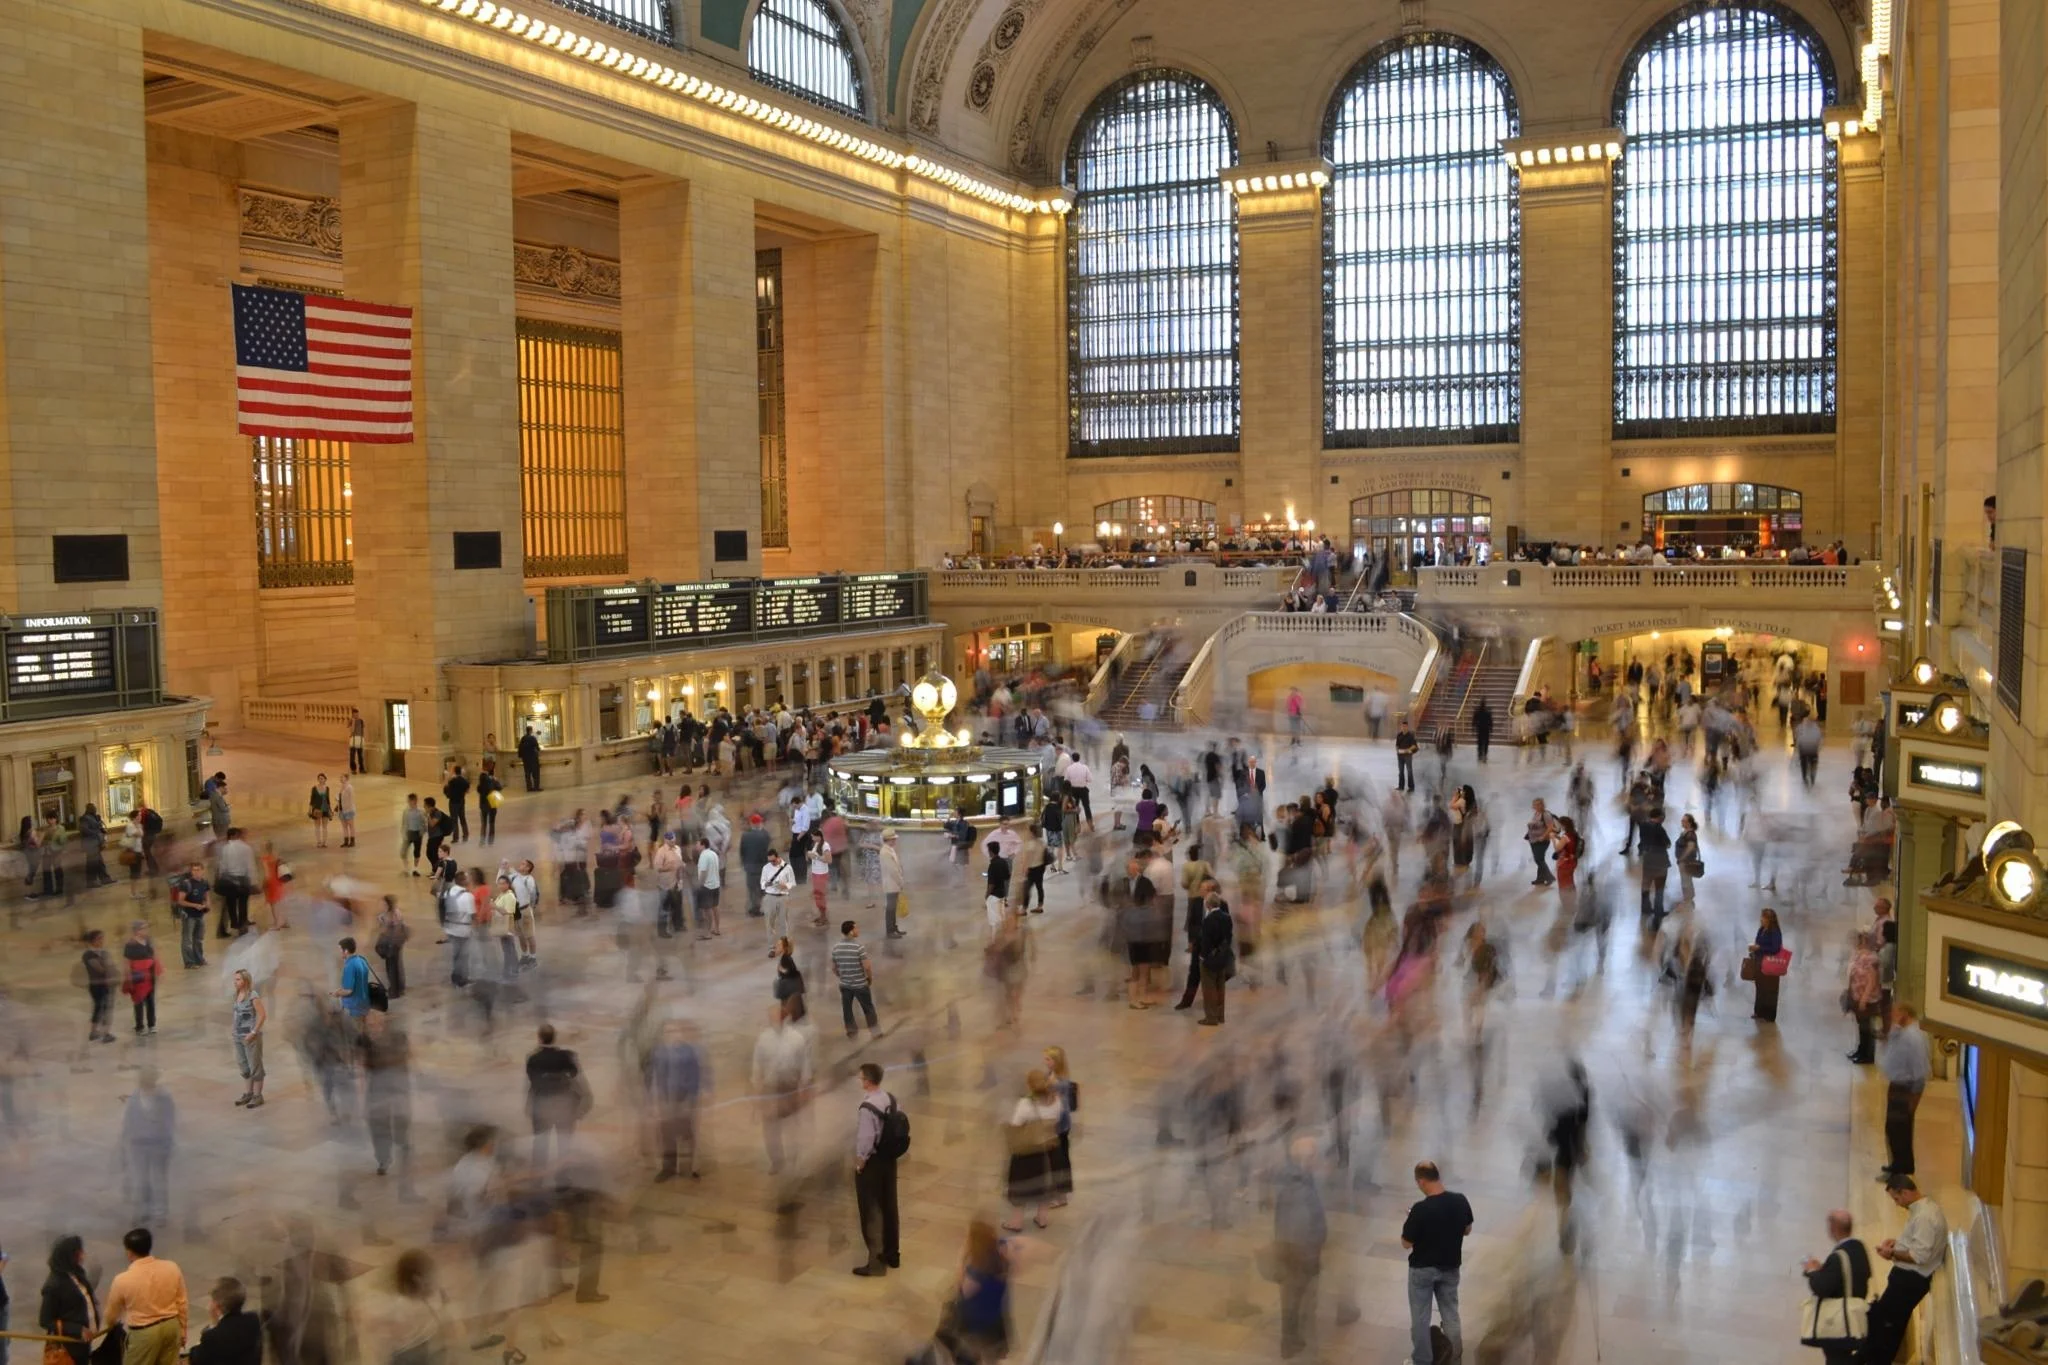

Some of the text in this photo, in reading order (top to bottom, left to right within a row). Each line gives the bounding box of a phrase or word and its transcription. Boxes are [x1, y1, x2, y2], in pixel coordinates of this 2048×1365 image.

[603, 587, 637, 595] INFORMATION
[25, 616, 91, 627] INFORMATION
[1592, 617, 1678, 633] TICKET MACHINES
[1711, 617, 1751, 628] TRACKS
[1920, 766, 1961, 784] TRACK
[1966, 964, 2044, 1005] TRACK
